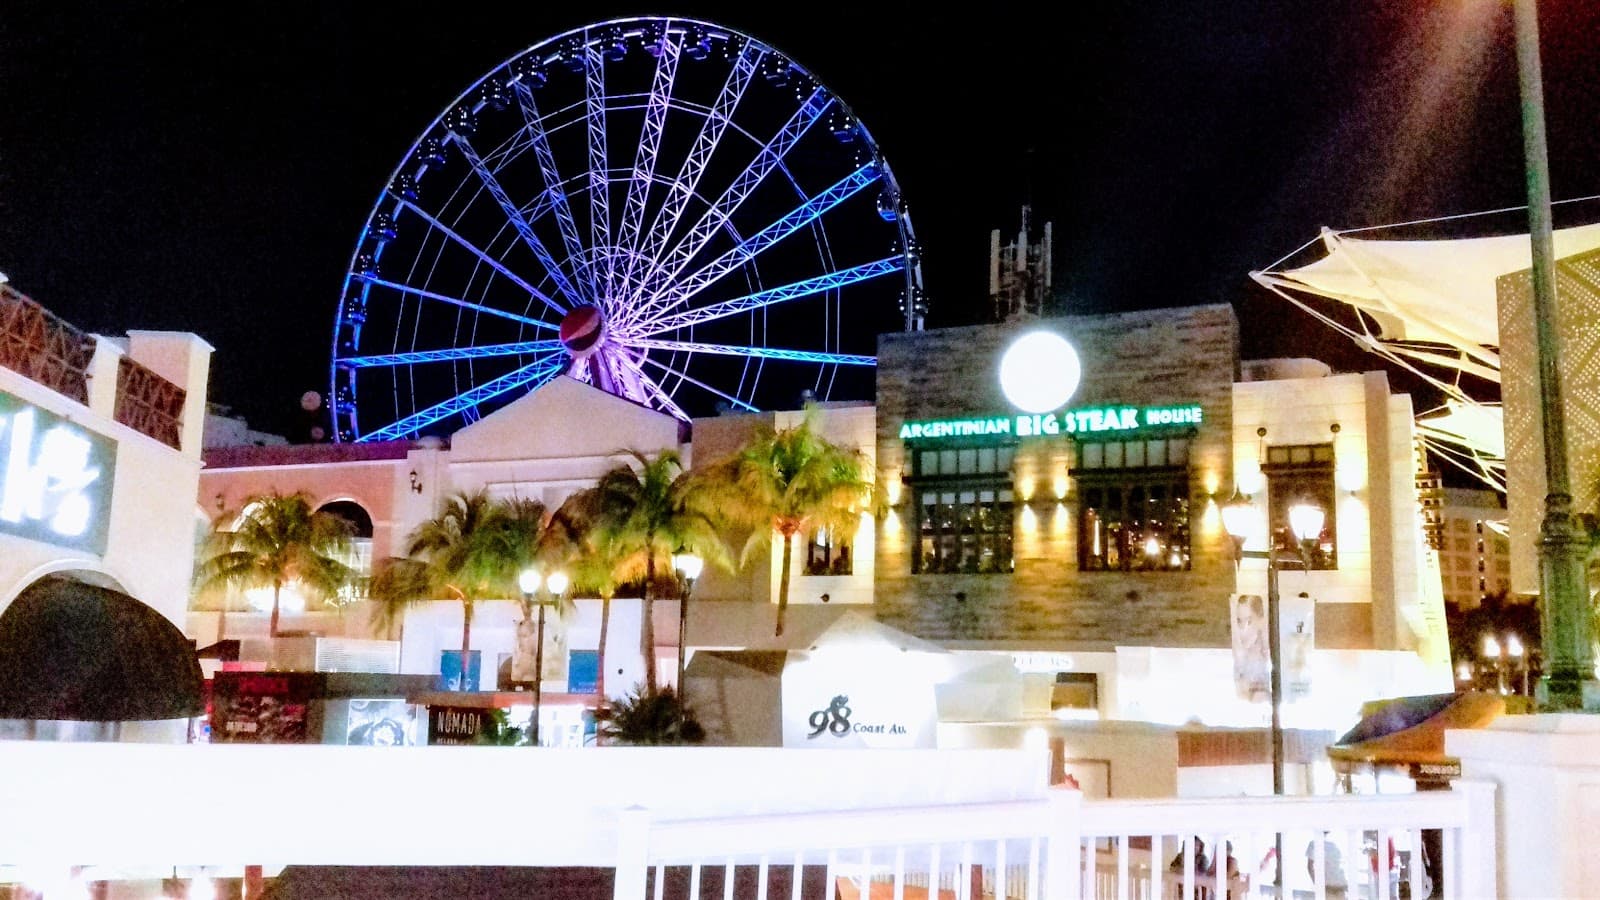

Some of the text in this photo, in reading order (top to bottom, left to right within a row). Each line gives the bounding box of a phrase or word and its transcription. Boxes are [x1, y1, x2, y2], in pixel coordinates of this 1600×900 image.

[900, 407, 1203, 438] ARGENTINIAN BIG STEAK HOUSE
[807, 702, 852, 739] 98
[853, 722, 885, 734] Coast
